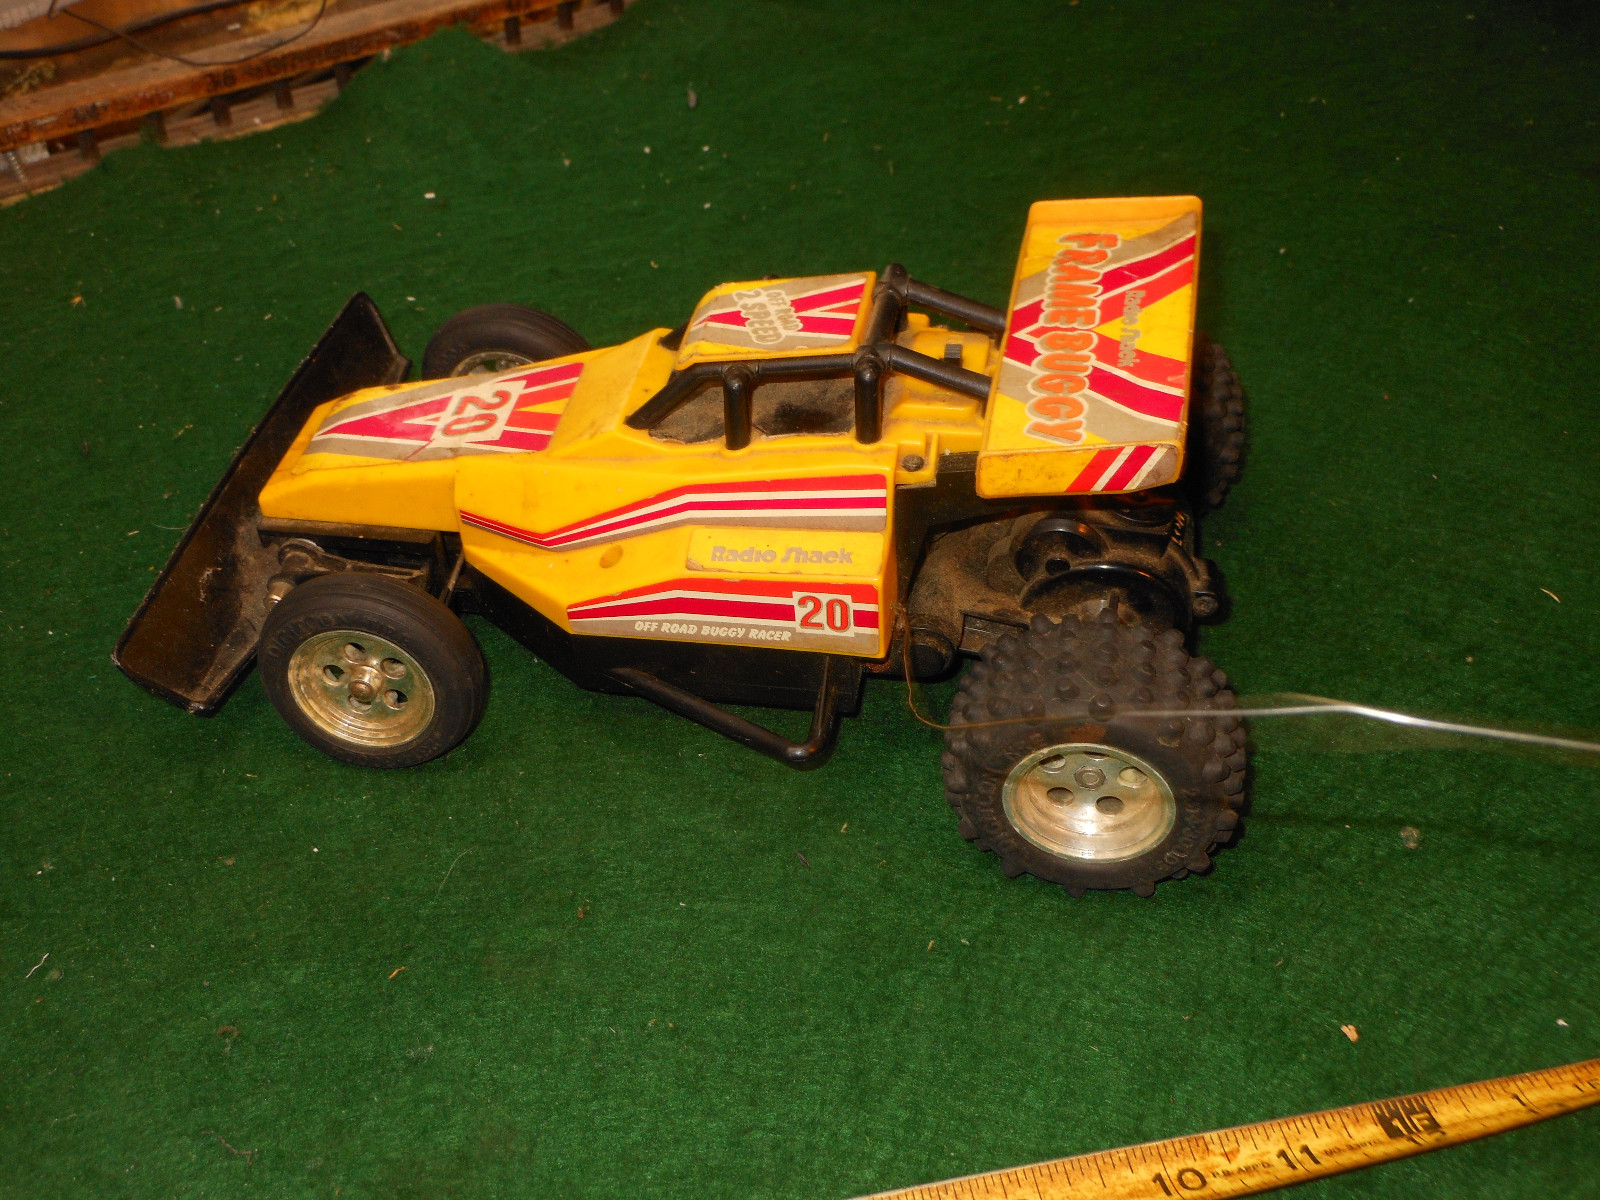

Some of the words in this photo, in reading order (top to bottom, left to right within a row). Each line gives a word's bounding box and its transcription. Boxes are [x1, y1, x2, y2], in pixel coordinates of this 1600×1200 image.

[1041, 233, 1120, 329] FRAME
[732, 289, 764, 304] 2
[765, 290, 791, 307] OFF
[1121, 290, 1146, 327] Radio
[741, 302, 785, 344] SPEED
[776, 306, 802, 332] ROAD
[1024, 330, 1098, 444] BUGGY
[443, 390, 512, 437] 20
[711, 545, 777, 563] Radio
[780, 546, 853, 565] Shack
[797, 595, 851, 632] 20
[634, 620, 659, 633] OFF
[661, 622, 698, 635] ROAD
[701, 624, 746, 640] BUGGY
[748, 629, 793, 642] RACER
[1276, 1144, 1321, 1171] 11
[1152, 1167, 1207, 1197] 10
